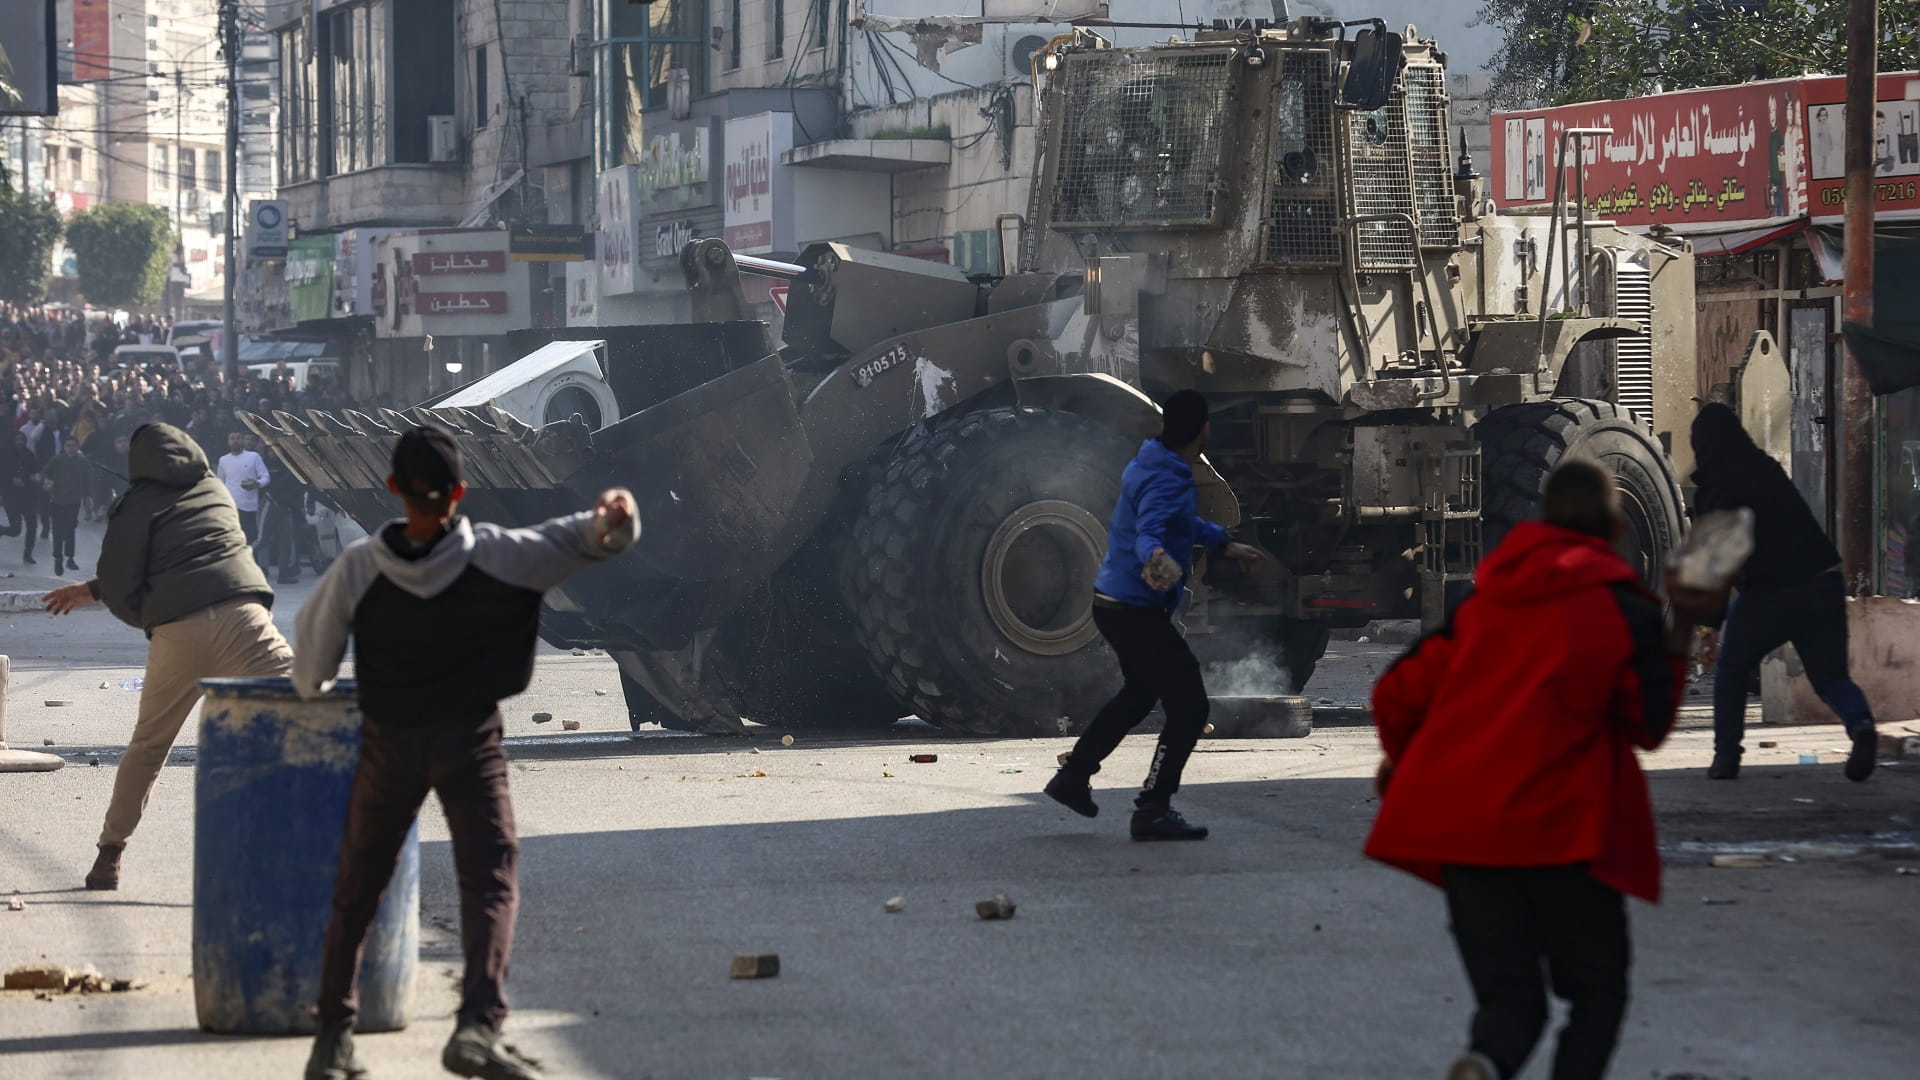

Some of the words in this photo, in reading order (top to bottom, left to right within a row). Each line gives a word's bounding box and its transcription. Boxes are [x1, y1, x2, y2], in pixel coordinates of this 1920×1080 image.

[1658, 107, 1700, 174] العامر
[1703, 104, 1756, 167] مؤسسة
[430, 253, 489, 273] مخابز
[430, 292, 491, 312] حطين
